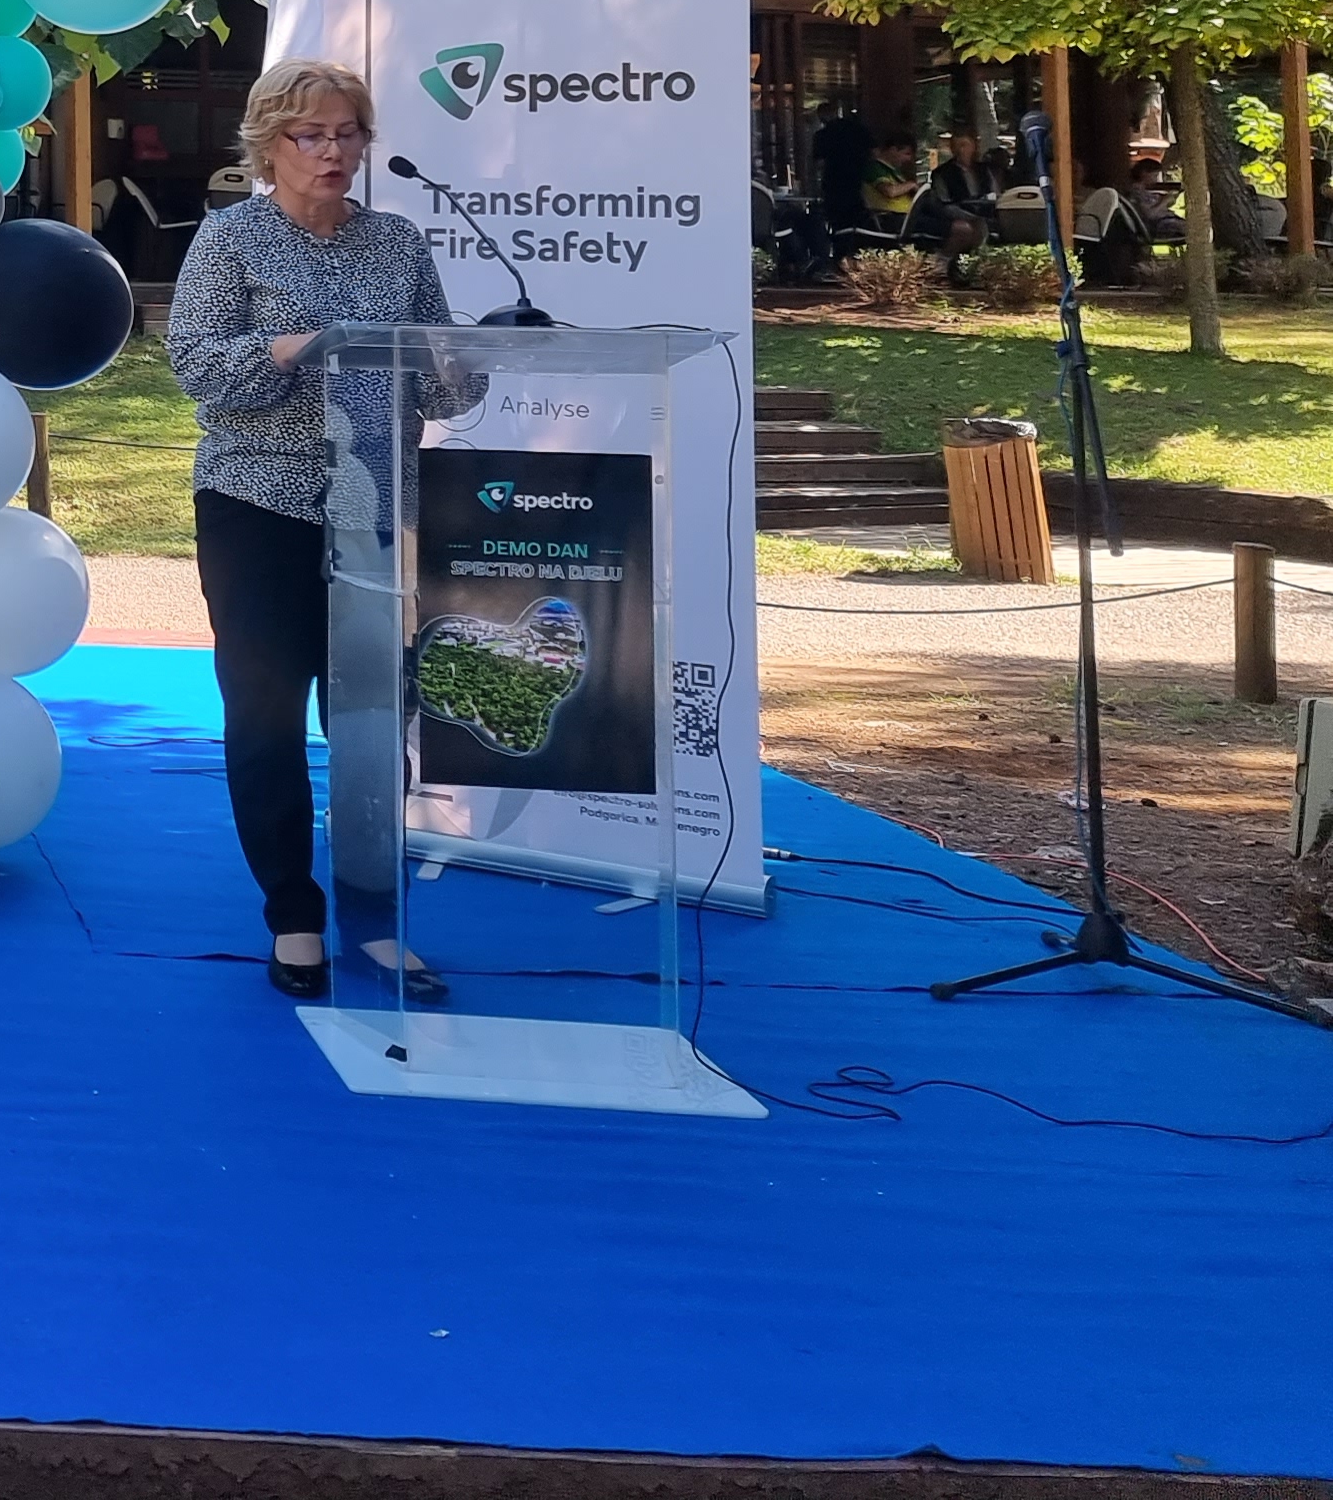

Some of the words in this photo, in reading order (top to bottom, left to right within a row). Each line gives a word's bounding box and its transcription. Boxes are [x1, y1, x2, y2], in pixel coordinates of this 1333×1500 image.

[503, 63, 696, 112] spectro
[422, 184, 703, 227] Transforming
[424, 227, 499, 261] Fire
[511, 230, 648, 273] Safety
[499, 396, 590, 421] Analyse
[513, 492, 594, 512] spectro
[483, 540, 541, 557] DEMO
[547, 543, 588, 559] DAN
[450, 560, 535, 579] SPECTRO
[538, 564, 565, 580] NA
[568, 565, 623, 582] DJELU
